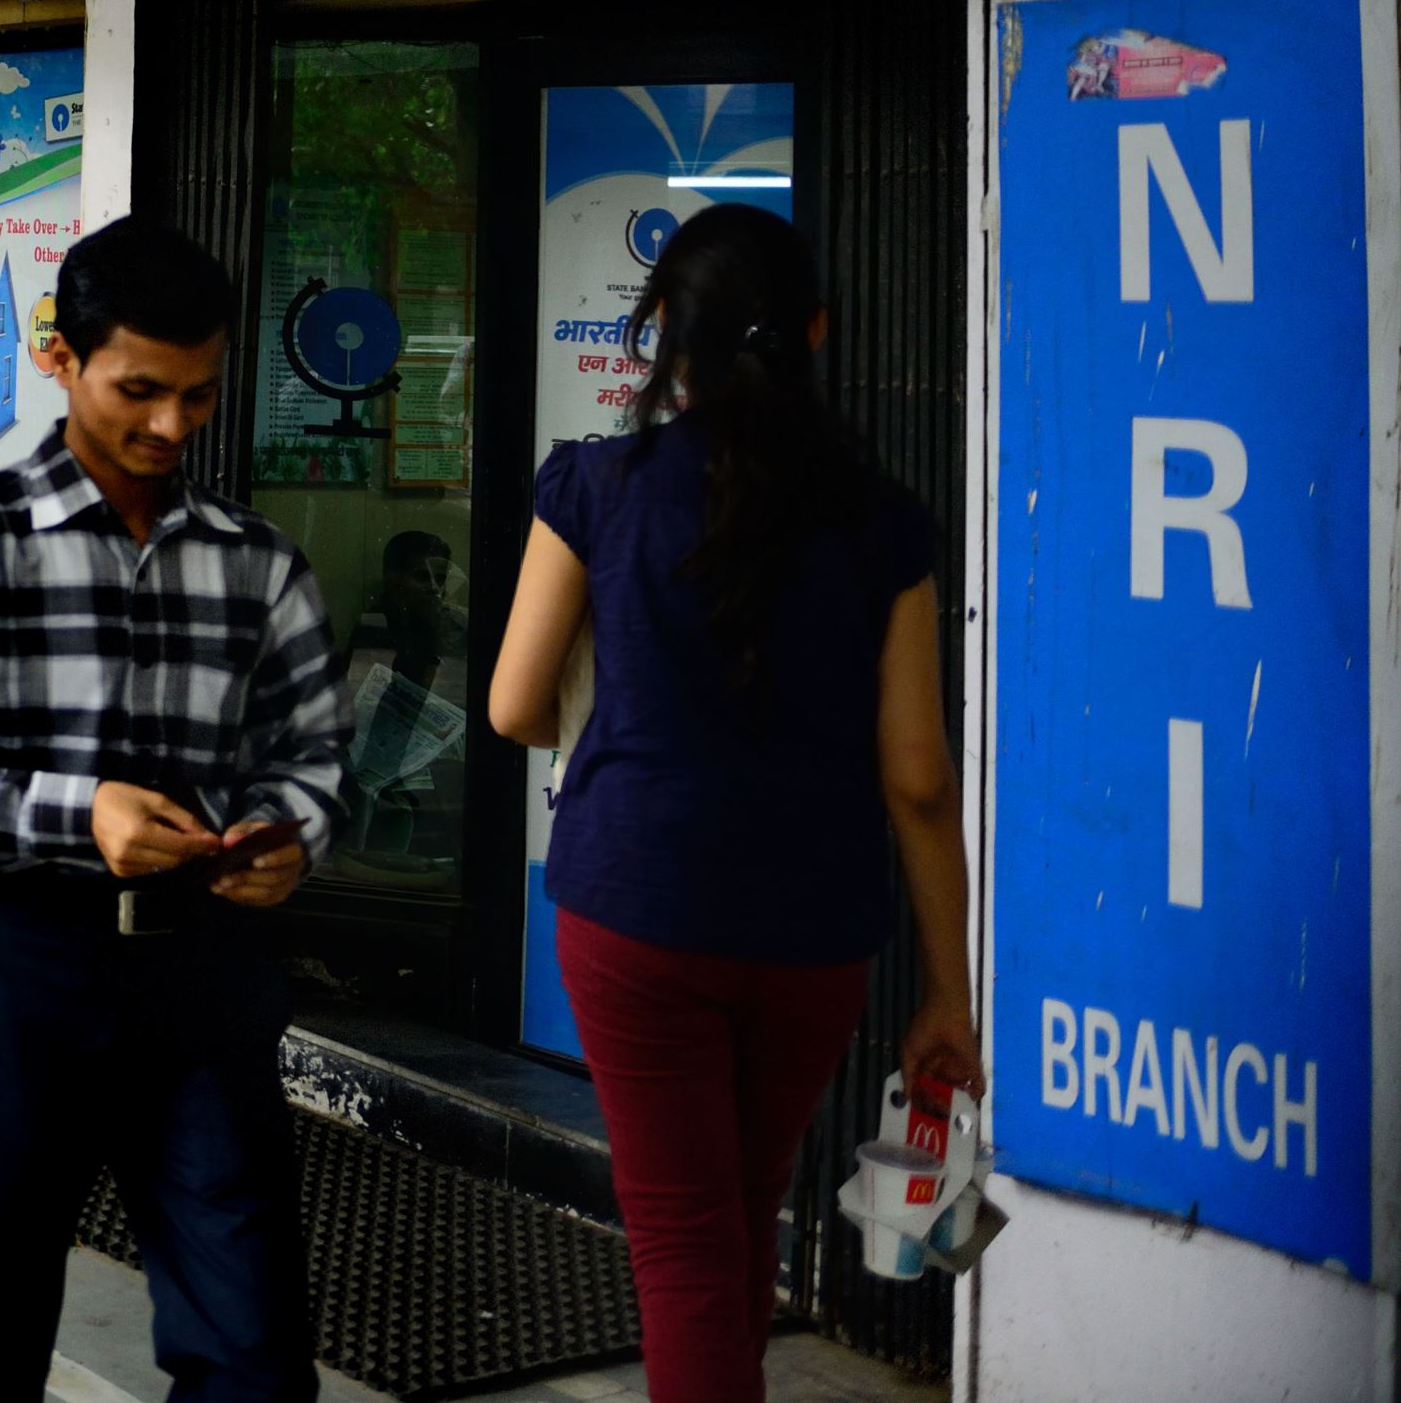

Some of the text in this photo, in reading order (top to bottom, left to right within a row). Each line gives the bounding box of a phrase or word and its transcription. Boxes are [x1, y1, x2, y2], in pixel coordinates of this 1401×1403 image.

[6, 218, 30, 234] Take
[33, 218, 58, 234] Over
[34, 246, 64, 262] Other
[607, 284, 628, 292] STATE
[578, 354, 609, 373] एन
[1042, 997, 1318, 1177] BRANCH
